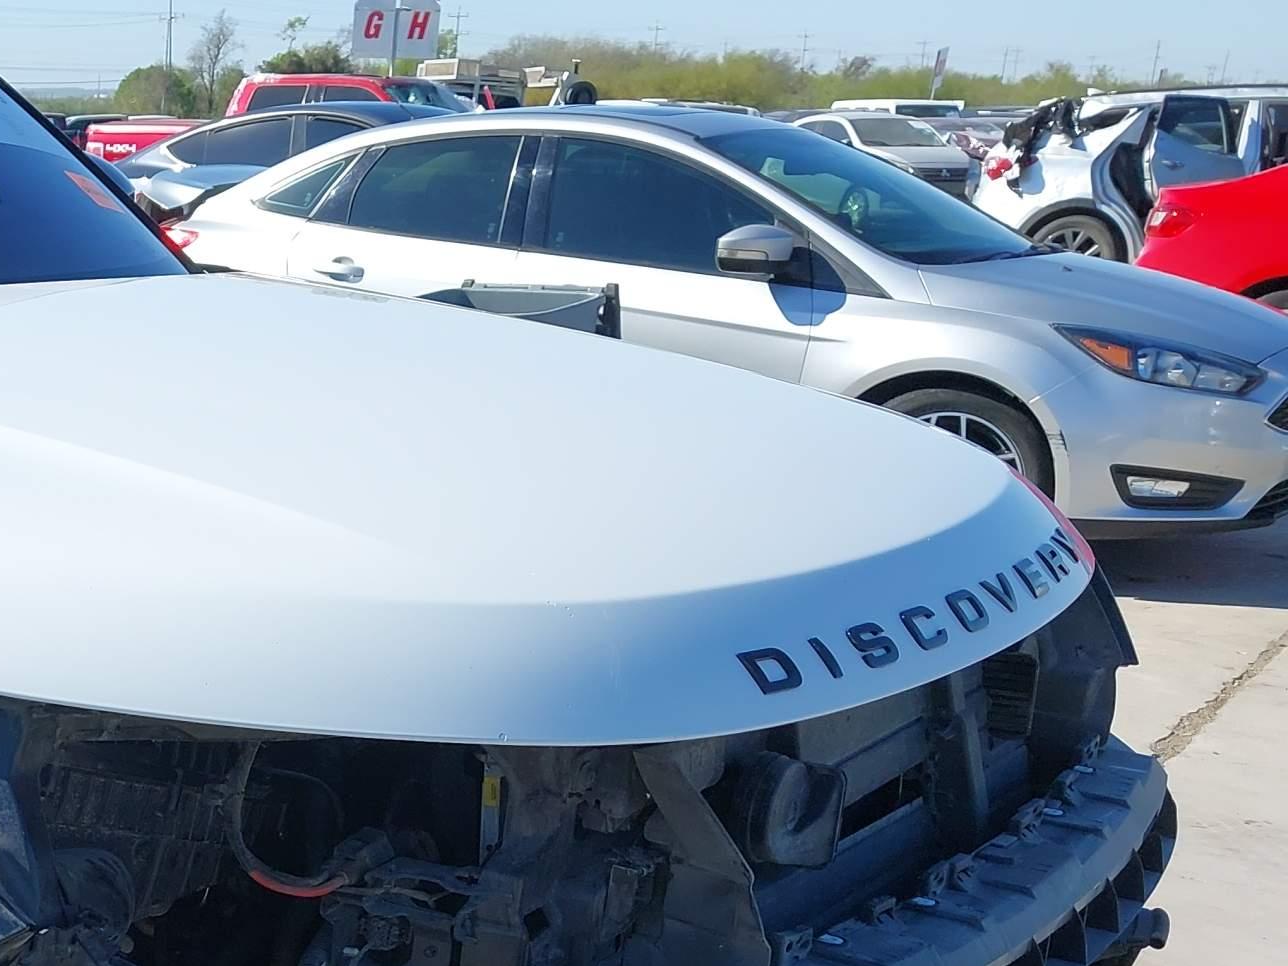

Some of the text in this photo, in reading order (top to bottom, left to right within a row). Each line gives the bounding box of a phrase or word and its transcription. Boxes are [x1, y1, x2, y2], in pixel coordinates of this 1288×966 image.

[364, 10, 431, 39] G H
[736, 527, 1081, 696] DISCOVERY
